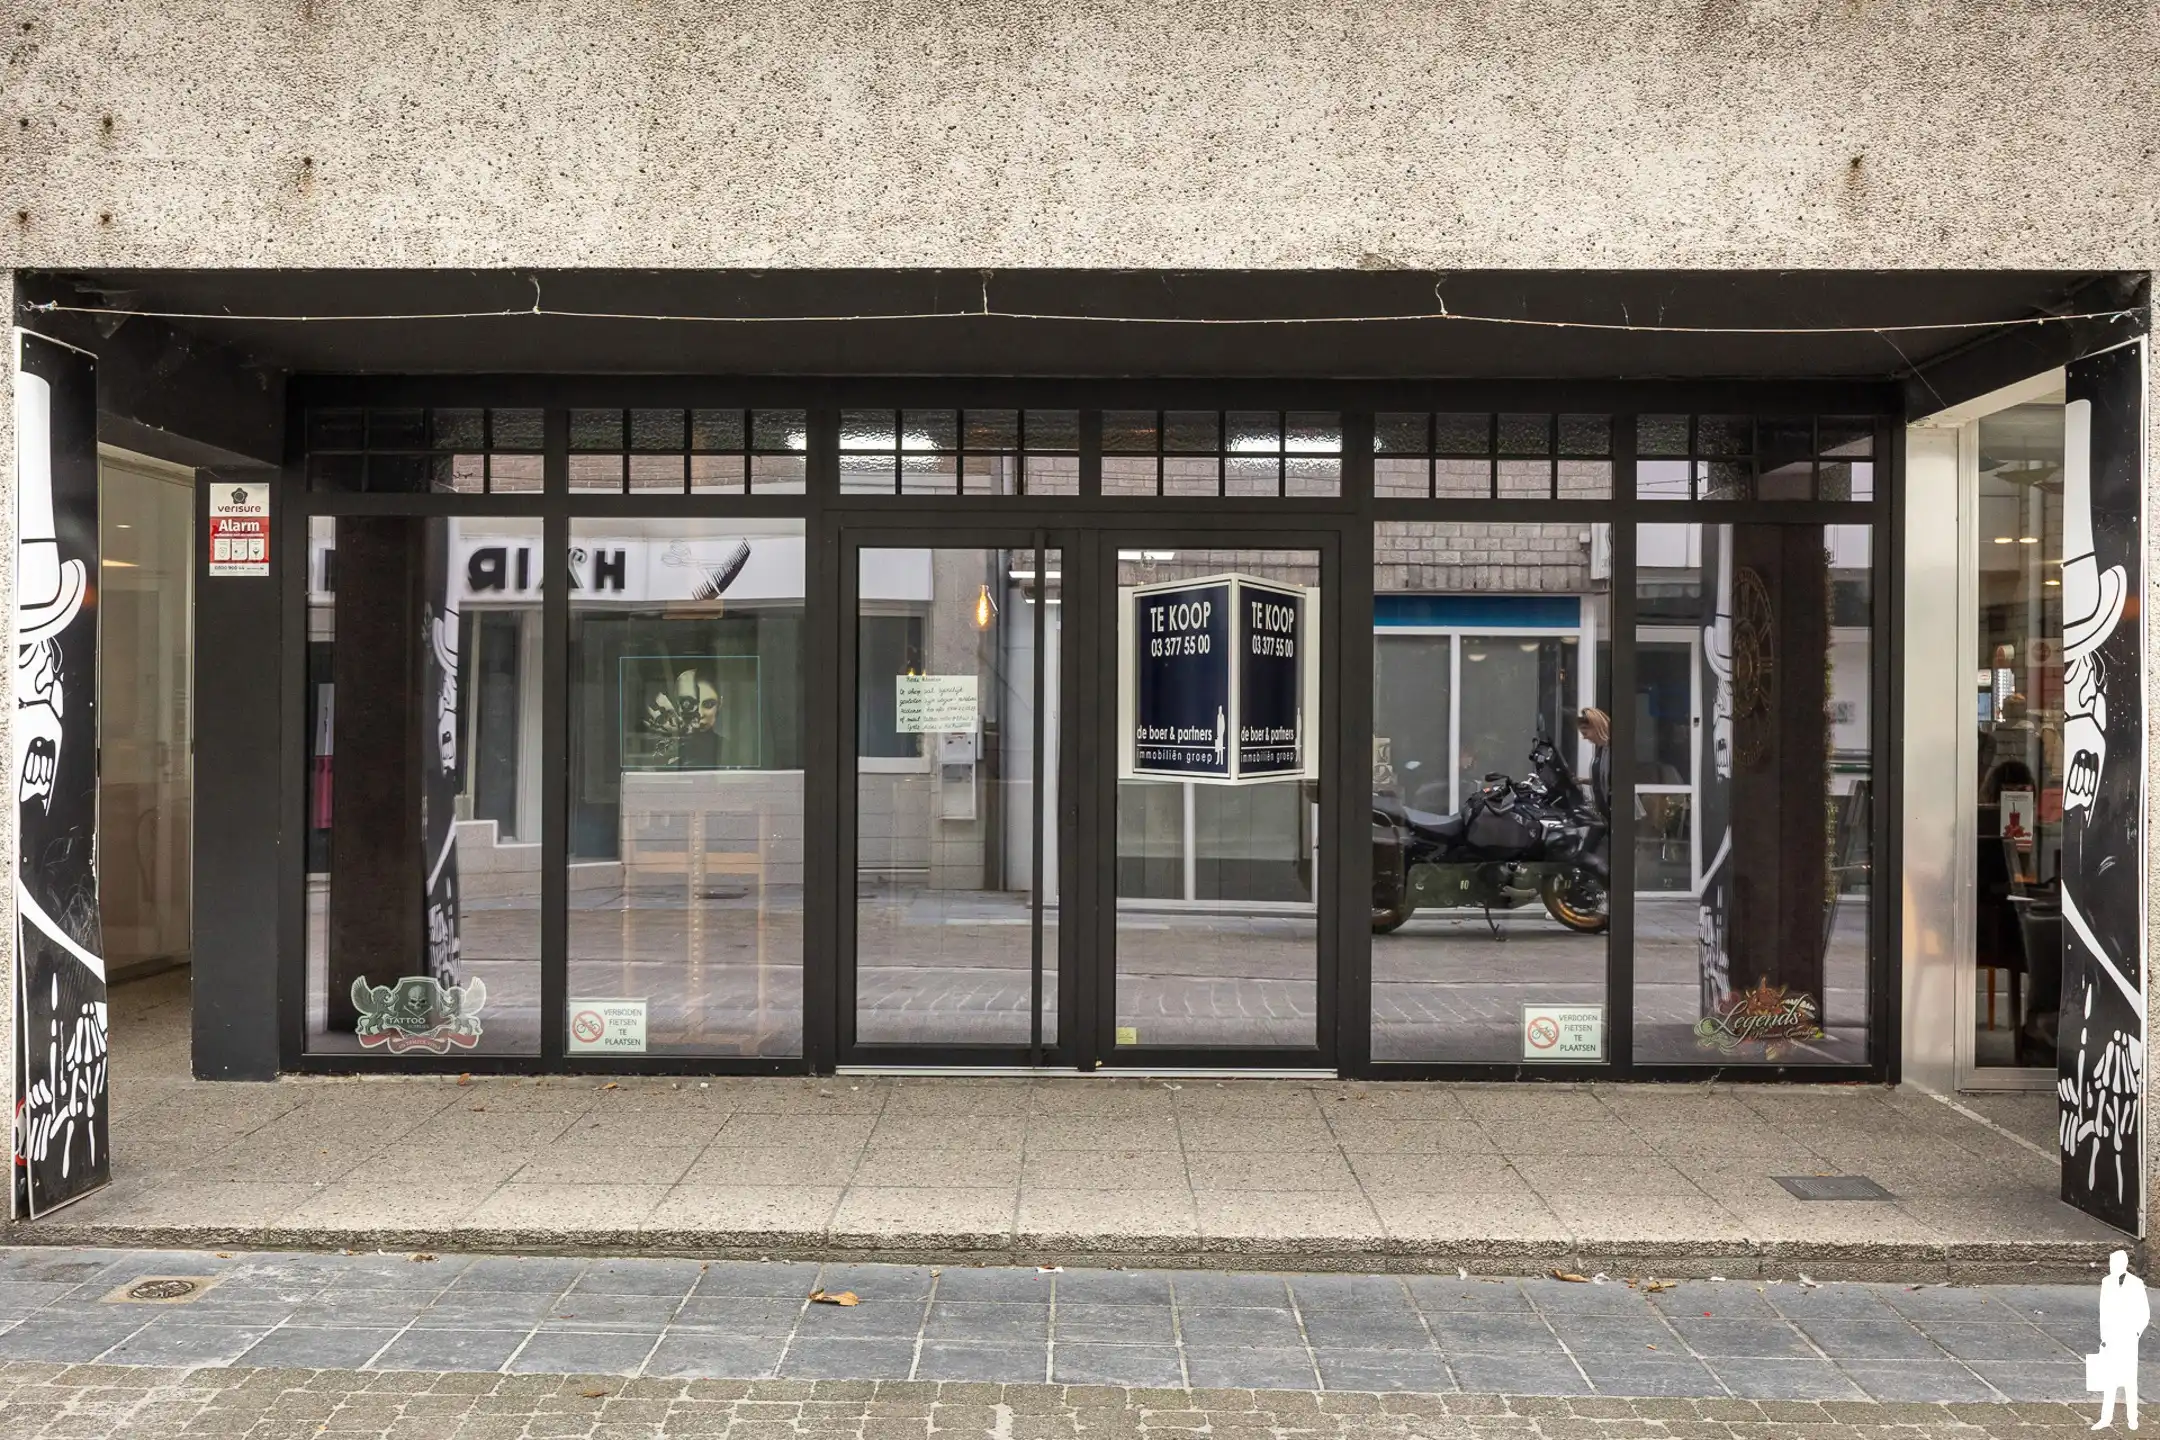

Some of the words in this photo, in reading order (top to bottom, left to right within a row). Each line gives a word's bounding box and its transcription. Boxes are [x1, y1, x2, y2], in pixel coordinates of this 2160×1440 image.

[217, 505, 261, 513] verisure
[218, 519, 260, 532] Alarm
[1150, 606, 1164, 633] TE
[1169, 601, 1212, 631] KOOP
[1251, 601, 1263, 629] TE
[1265, 602, 1295, 633] KOOP
[1151, 638, 1163, 657] 03
[1164, 636, 1182, 656] 377
[1184, 635, 1196, 655] 55
[1198, 634, 1211, 654] 00
[1252, 635, 1261, 655] 03
[1262, 636, 1275, 656] 377
[1275, 637, 1284, 657] 55
[1285, 638, 1294, 658] 00
[1137, 725, 1147, 740] de
[1149, 725, 1168, 740] boer
[1169, 726, 1176, 740] &
[1177, 725, 1212, 744] partners
[1241, 726, 1250, 741] de
[1250, 726, 1265, 741] boer
[1265, 727, 1270, 741] &
[1270, 726, 1294, 744] partners
[1137, 748, 1182, 761] immobiliën
[1186, 752, 1213, 765] groep
[1241, 750, 1274, 763] immobiliën
[1276, 751, 1294, 763] groep
[603, 1008, 642, 1016] VERBODEN
[609, 1018, 637, 1026] FIETSEN
[1699, 994, 1809, 1048] Legends
[618, 1028, 627, 1036] TE
[604, 1038, 641, 1046] PLAATSEN
[1560, 1044, 1596, 1052] PLAATSEN
